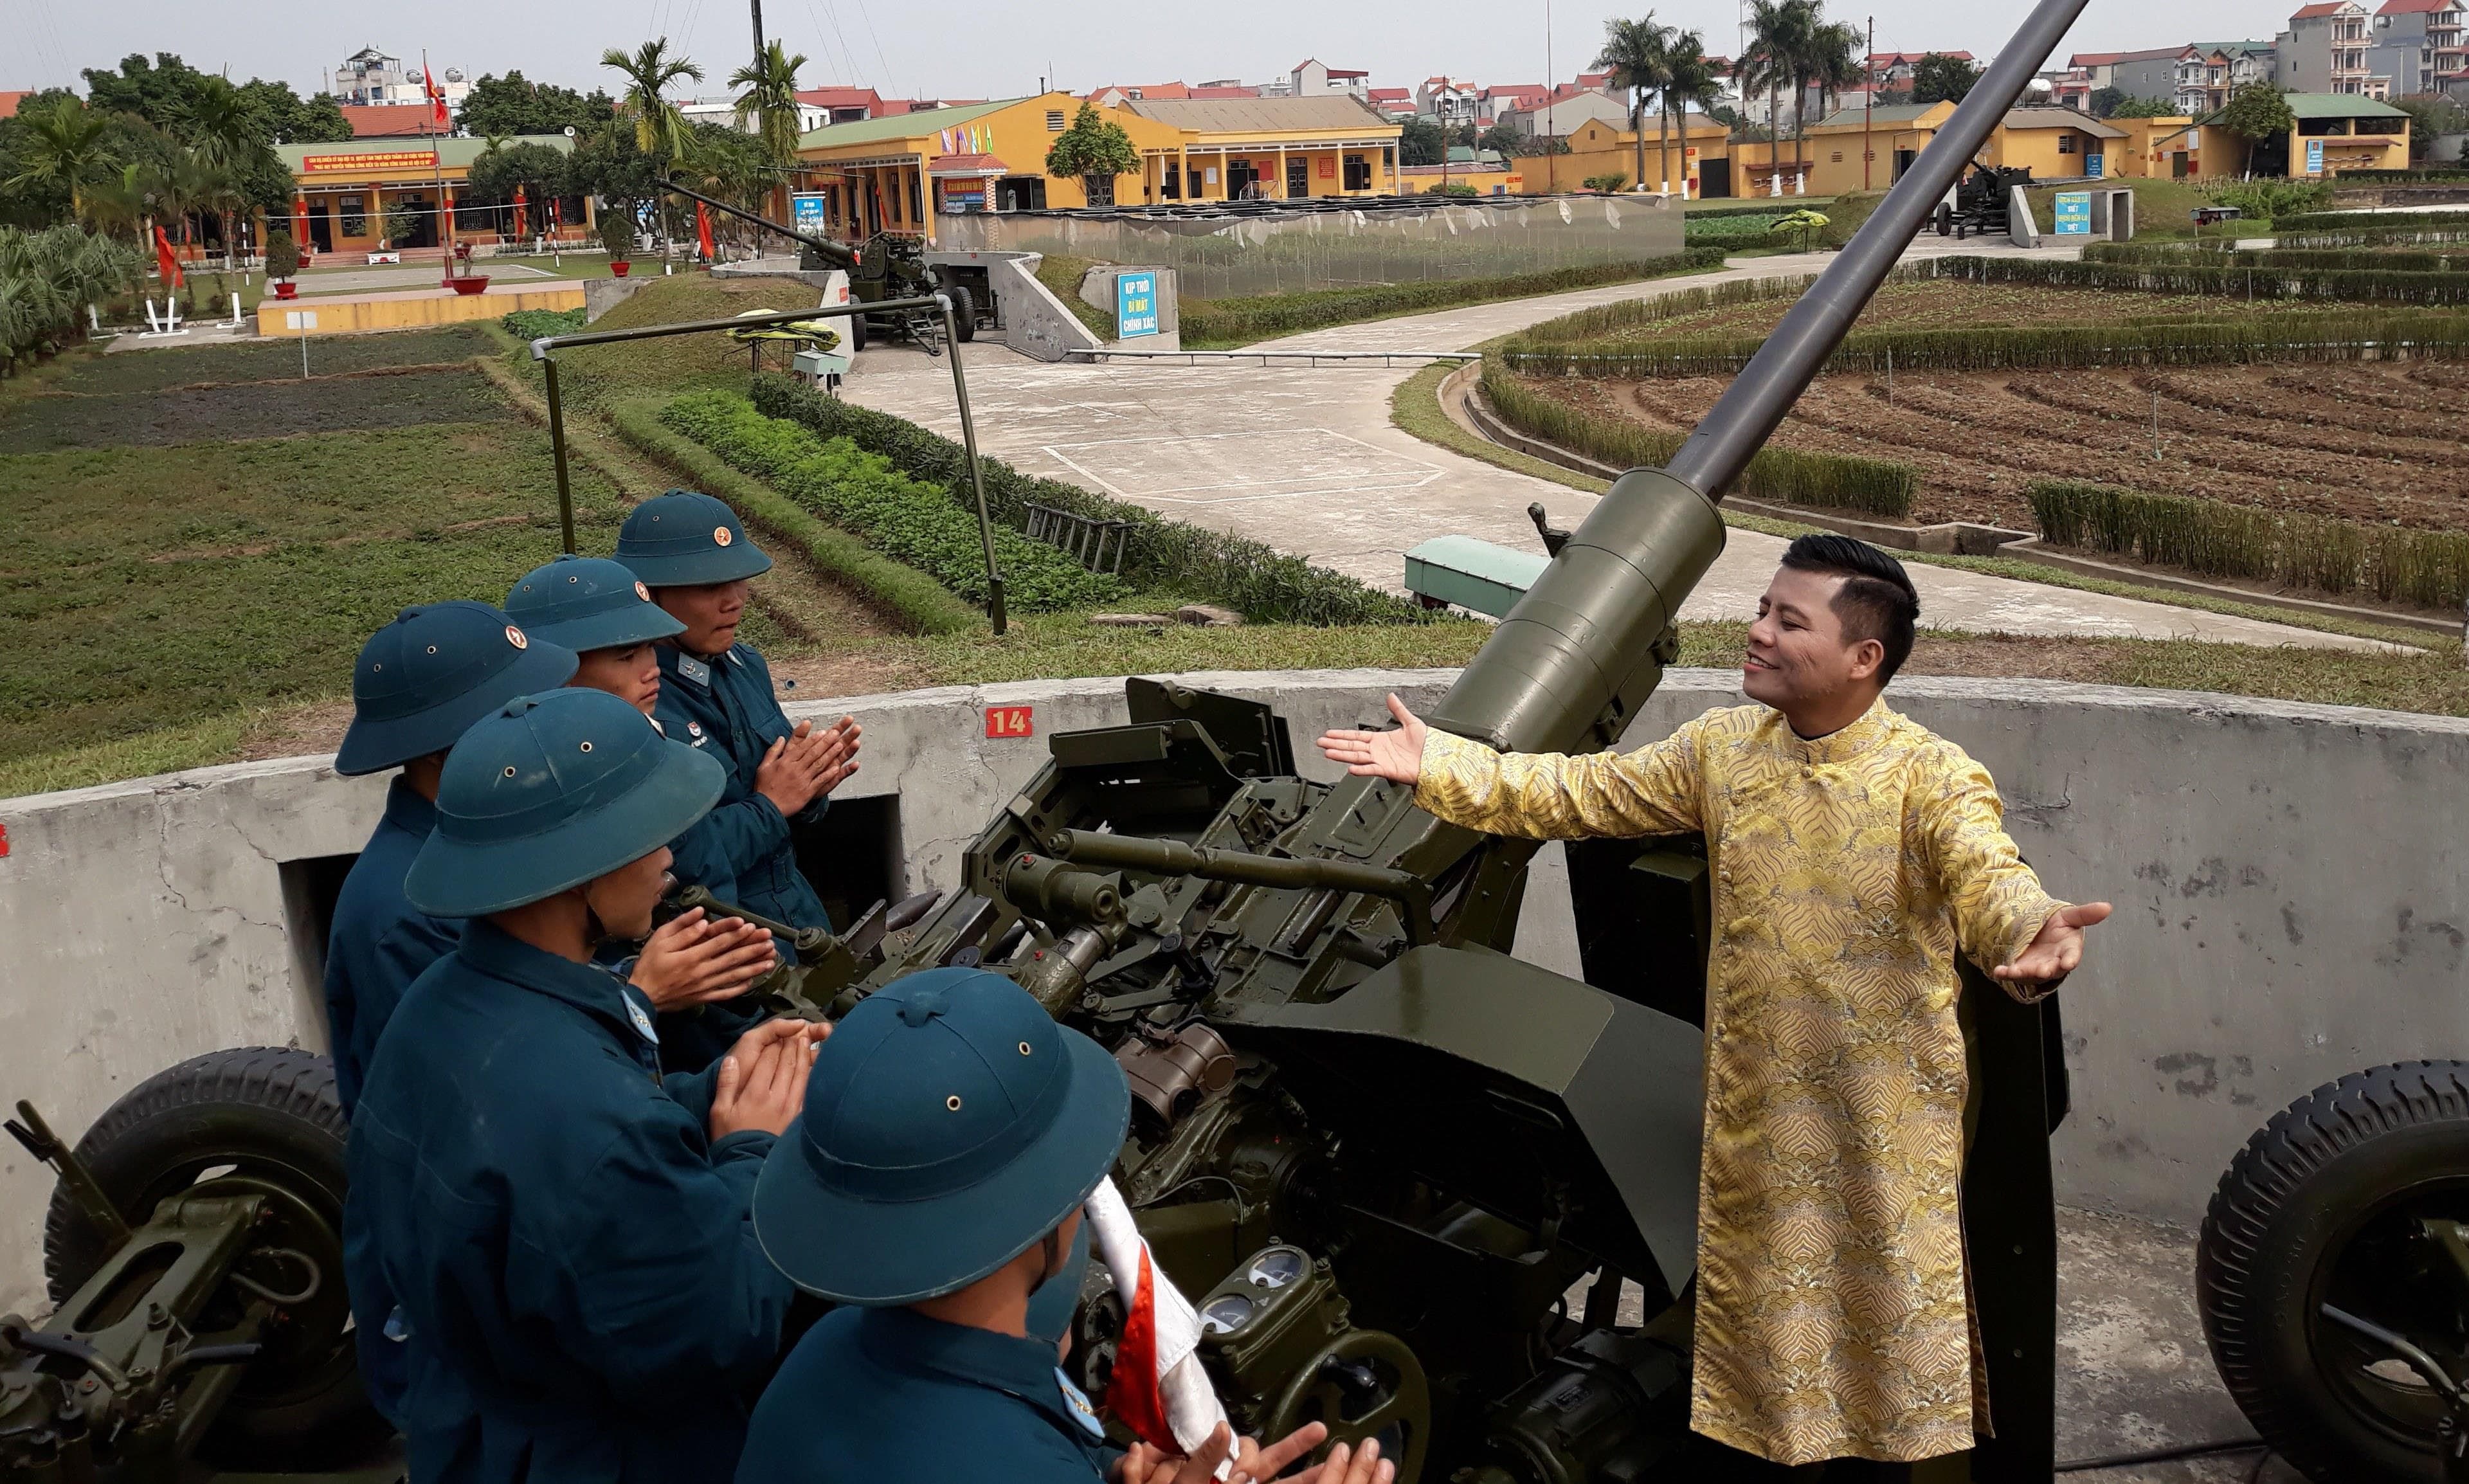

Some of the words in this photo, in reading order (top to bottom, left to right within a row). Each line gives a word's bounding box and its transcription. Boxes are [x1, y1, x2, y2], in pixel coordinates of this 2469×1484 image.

[1125, 281, 1135, 297] KỊP
[1136, 276, 1150, 293] THỜI
[1135, 297, 1148, 314] MẬT
[1123, 316, 1142, 332] CHÍNH
[1143, 314, 1155, 329] XÁC
[993, 710, 1026, 734] 14
